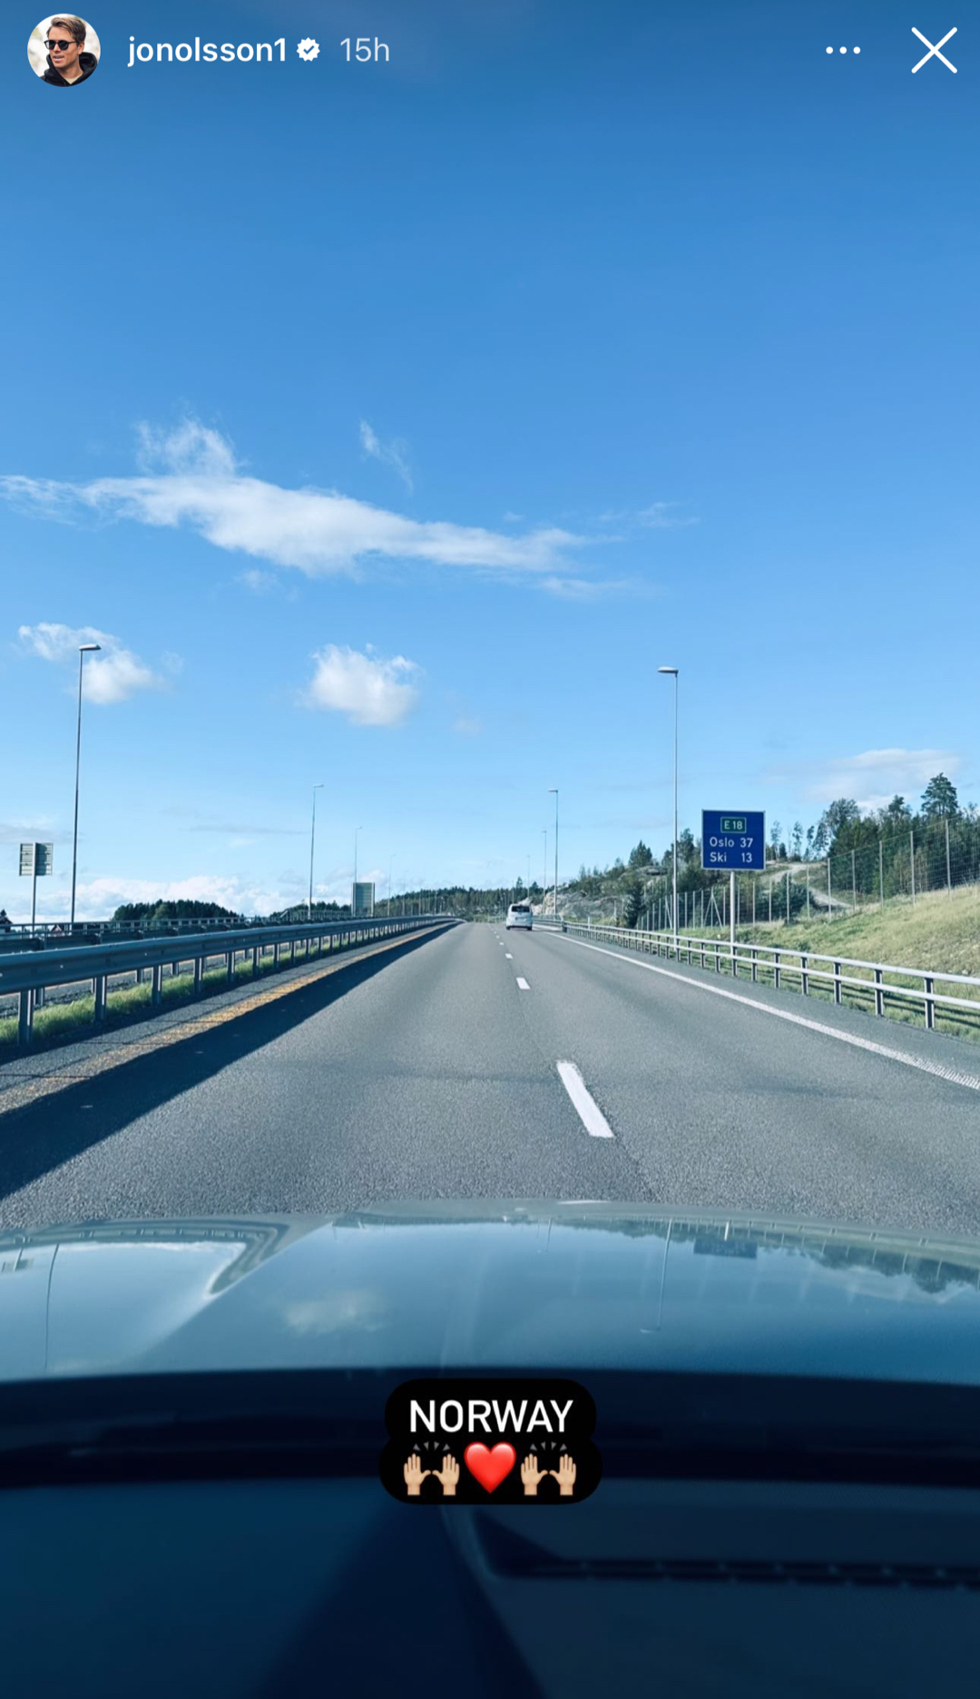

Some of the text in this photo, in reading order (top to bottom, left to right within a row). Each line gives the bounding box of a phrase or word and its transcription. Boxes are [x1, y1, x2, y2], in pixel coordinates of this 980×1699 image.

[709, 836, 753, 848] Oslo 37
[709, 851, 753, 863] Ski 13
